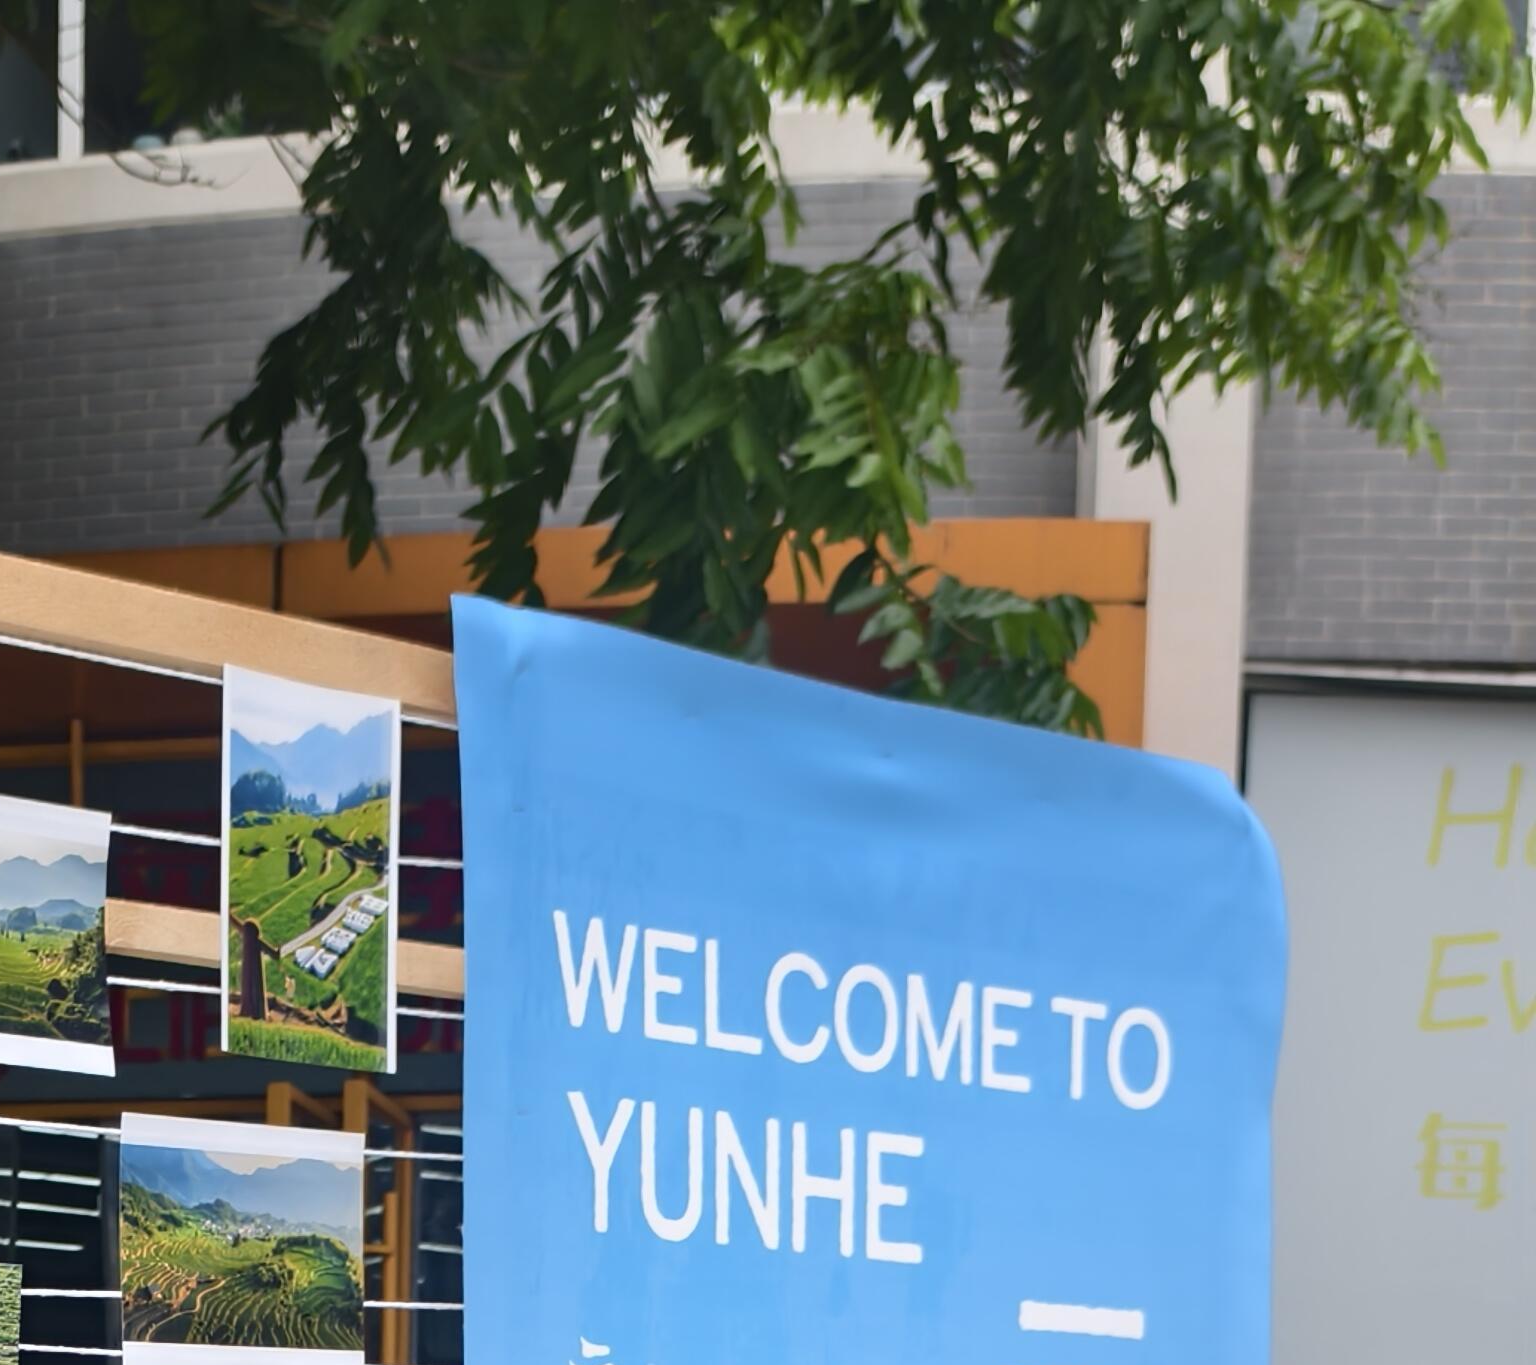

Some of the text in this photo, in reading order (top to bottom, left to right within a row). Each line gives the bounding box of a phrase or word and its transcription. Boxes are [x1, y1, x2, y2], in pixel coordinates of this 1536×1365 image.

[553, 909, 1171, 1110] WELCOME TO
[567, 1090, 925, 1264] YUNHE
